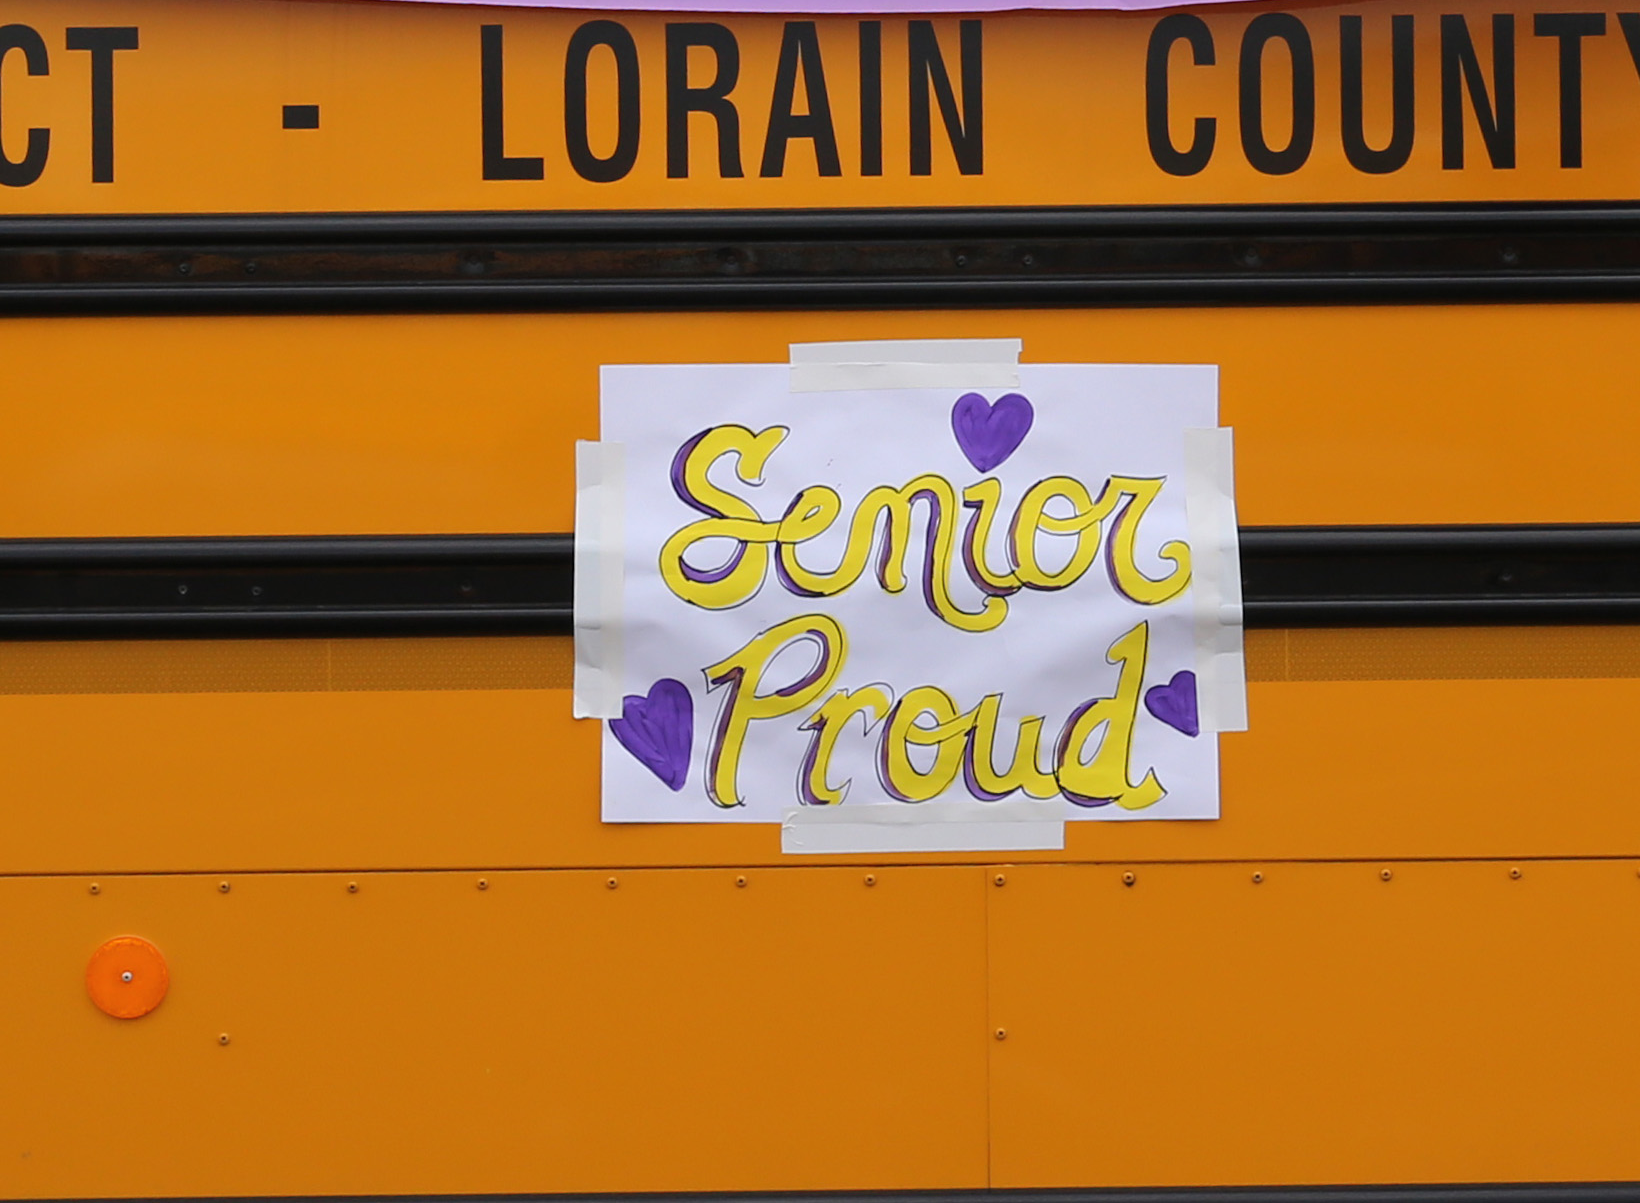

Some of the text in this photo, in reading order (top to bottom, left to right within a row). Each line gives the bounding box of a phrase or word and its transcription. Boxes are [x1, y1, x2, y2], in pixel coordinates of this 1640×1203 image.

[281, 103, 320, 130] -
[480, 19, 985, 183] LORAIN
[659, 423, 1192, 633] Senior
[700, 613, 1167, 810] Proud
